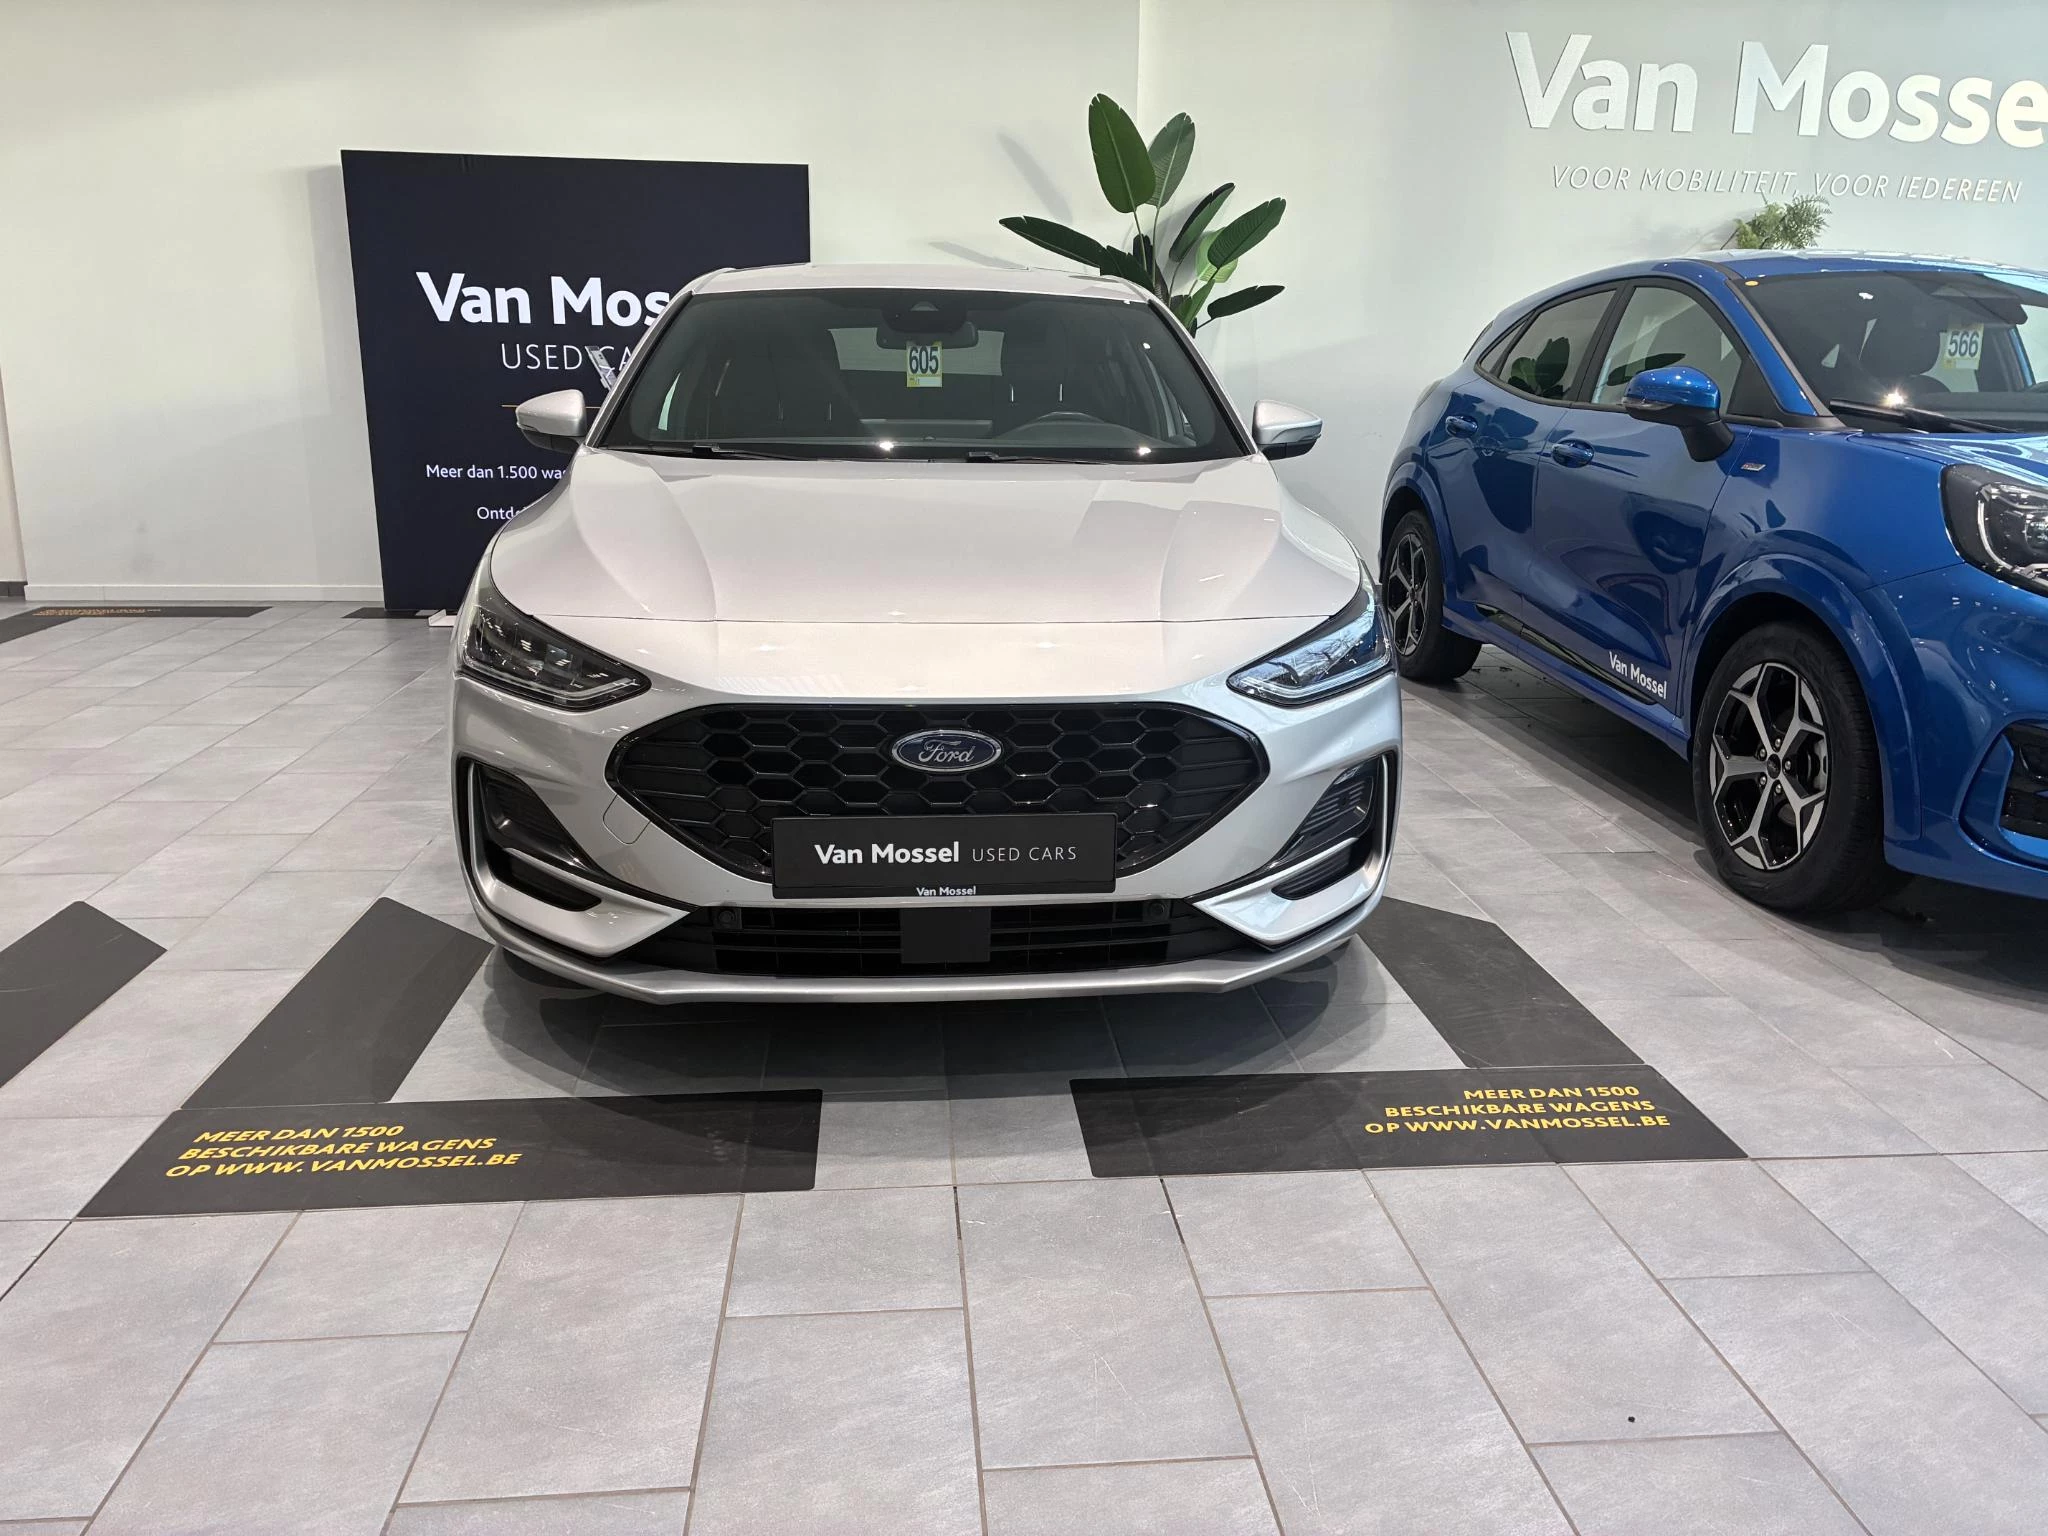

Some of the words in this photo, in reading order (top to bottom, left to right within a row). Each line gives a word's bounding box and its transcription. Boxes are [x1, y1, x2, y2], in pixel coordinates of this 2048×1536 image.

[1506, 31, 1698, 132] Van
[1733, 41, 2048, 148] Mosse
[1552, 165, 1629, 189] VOOR
[1640, 168, 1801, 198] MOBILITEIT,
[1813, 173, 1888, 198] VOOR
[1898, 175, 2022, 203] IEDEREEN
[416, 272, 531, 324] Van
[1948, 330, 1979, 357] 566
[501, 343, 583, 370] USED
[909, 346, 939, 375] 605
[426, 464, 463, 478] Meer
[467, 464, 493, 479] dan
[497, 465, 537, 479] 1.500
[1609, 650, 1628, 677] Van
[1630, 663, 1667, 700] Mossel
[918, 740, 976, 763] Ford
[814, 844, 863, 864] Van
[871, 841, 959, 864] Mossel
[971, 847, 1020, 863] USED
[1028, 846, 1077, 862] CARS
[916, 886, 936, 896] Van
[938, 885, 977, 896] Mossel
[1463, 1089, 1525, 1099] MEER
[1529, 1087, 1582, 1098] DAN
[1585, 1085, 1640, 1097] 1500
[1384, 1102, 1546, 1117] BESCHIKBARE
[1548, 1099, 1655, 1113] WAGENS
[193, 1130, 270, 1144] MEER
[271, 1127, 341, 1141] DAN
[344, 1125, 404, 1138] 1500
[1364, 1122, 1400, 1134] OP
[1404, 1115, 1671, 1133] WWW.VANMOSSEL.BE
[178, 1142, 373, 1161] BESCHIKBARE
[376, 1137, 497, 1153] WAGENS
[165, 1165, 213, 1178] OP
[214, 1153, 523, 1177] WWW.VANMOSSEL.BE
